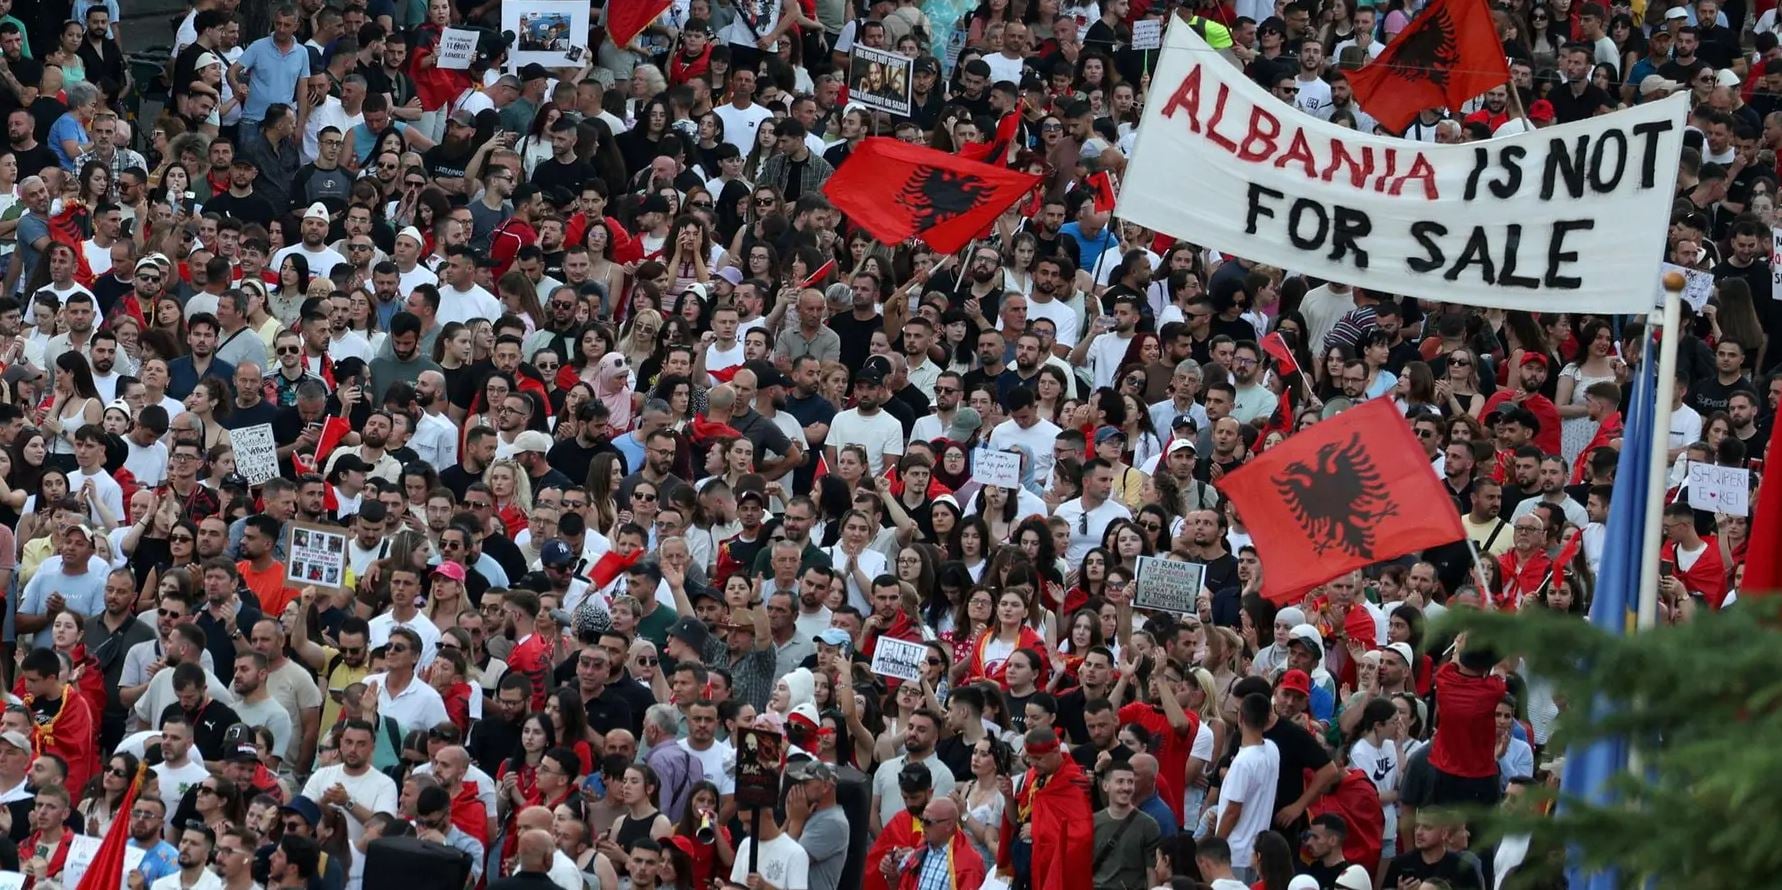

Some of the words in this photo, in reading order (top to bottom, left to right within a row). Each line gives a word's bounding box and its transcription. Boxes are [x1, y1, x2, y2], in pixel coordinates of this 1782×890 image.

[856, 48, 865, 59] ONE
[865, 50, 878, 63] DOES
[878, 53, 888, 65] NOT
[888, 57, 907, 69] SIMPLY
[861, 92, 885, 107] BAREFOOT
[885, 97, 892, 107] ON
[892, 99, 908, 111] SAZAN
[1162, 64, 1438, 200] ALBANIA
[1463, 145, 1526, 200] IS
[1540, 119, 1673, 200] NOT
[1245, 181, 1372, 268] FOR
[1406, 219, 1595, 289] SALE
[1161, 561, 1186, 570] RAMA
